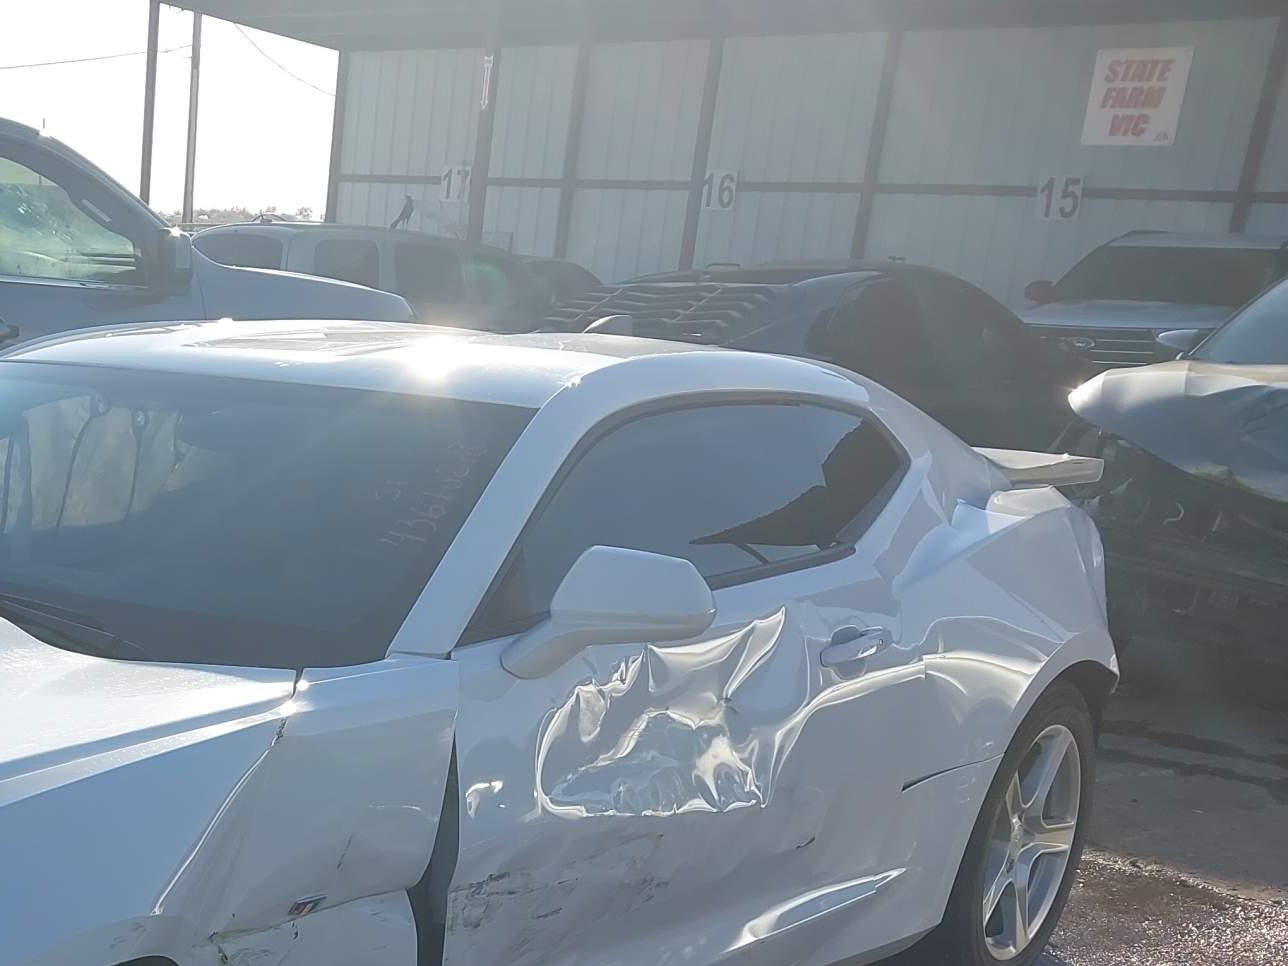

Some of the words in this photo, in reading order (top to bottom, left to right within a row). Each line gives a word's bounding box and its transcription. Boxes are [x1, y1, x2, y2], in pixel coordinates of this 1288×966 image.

[1103, 58, 1176, 83] STATE
[1100, 85, 1167, 109] FARM
[1108, 113, 1151, 137] VIC
[442, 167, 471, 200] 17
[703, 172, 735, 209] 16
[1039, 176, 1081, 218] 15
